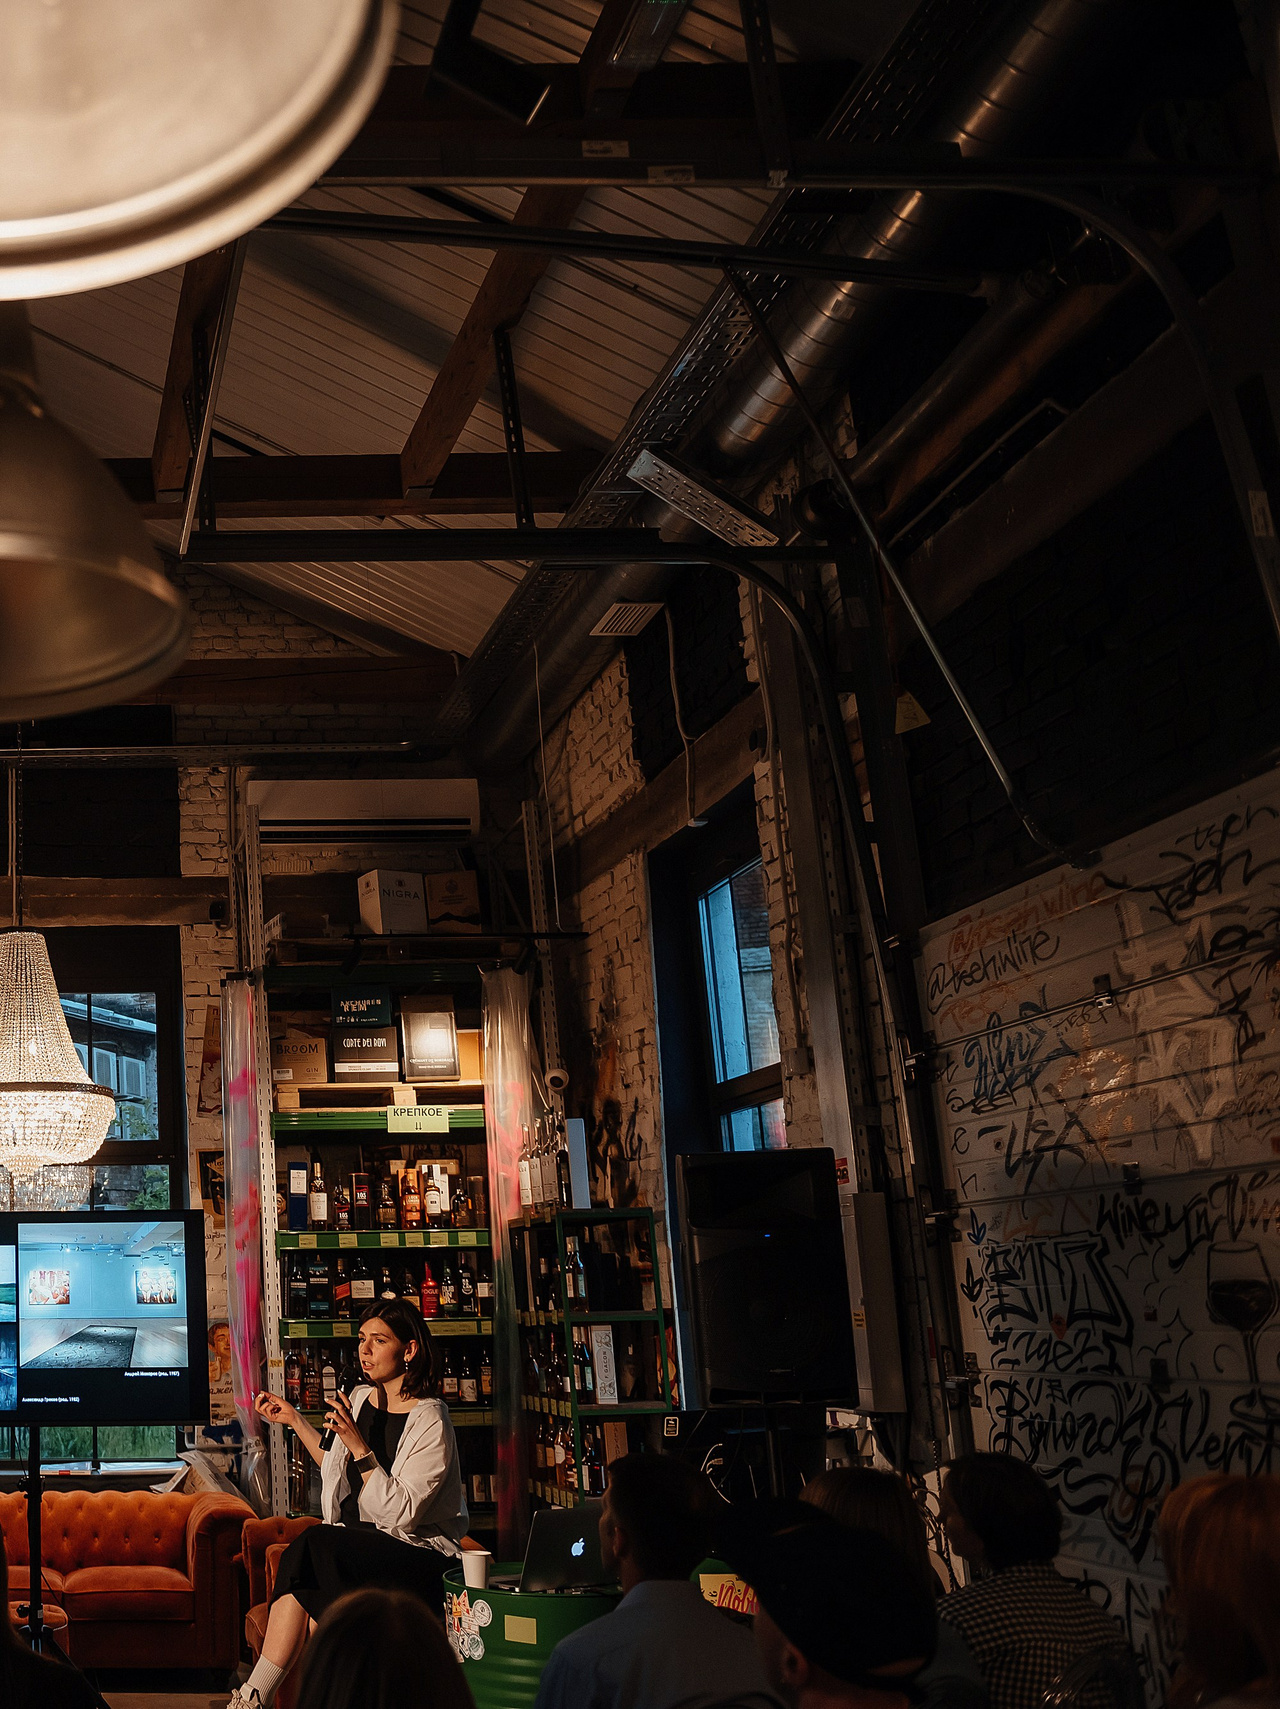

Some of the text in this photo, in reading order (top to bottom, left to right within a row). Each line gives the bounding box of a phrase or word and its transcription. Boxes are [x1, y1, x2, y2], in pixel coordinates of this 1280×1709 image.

[382, 888, 421, 900] NIGRA
[276, 1043, 320, 1055] BROOM
[393, 1108, 443, 1117] КРЕПКОЕ
[356, 1192, 367, 1200] 105
